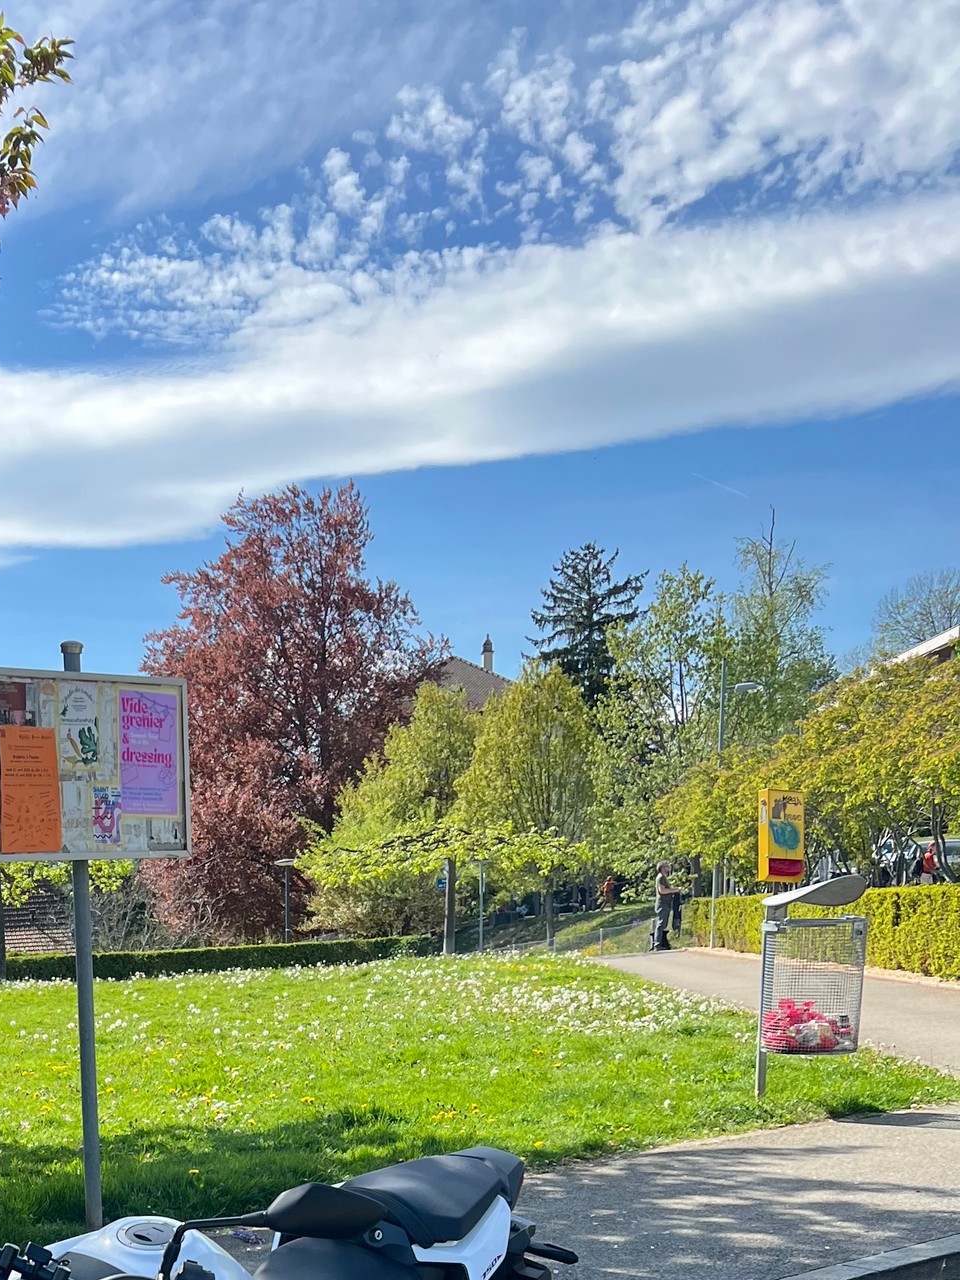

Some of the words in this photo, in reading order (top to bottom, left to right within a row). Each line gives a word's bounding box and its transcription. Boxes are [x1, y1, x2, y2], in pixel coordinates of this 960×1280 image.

[121, 697, 148, 714] Vide
[122, 712, 165, 730] grenier
[122, 732, 129, 744] &
[121, 747, 172, 768] dressing
